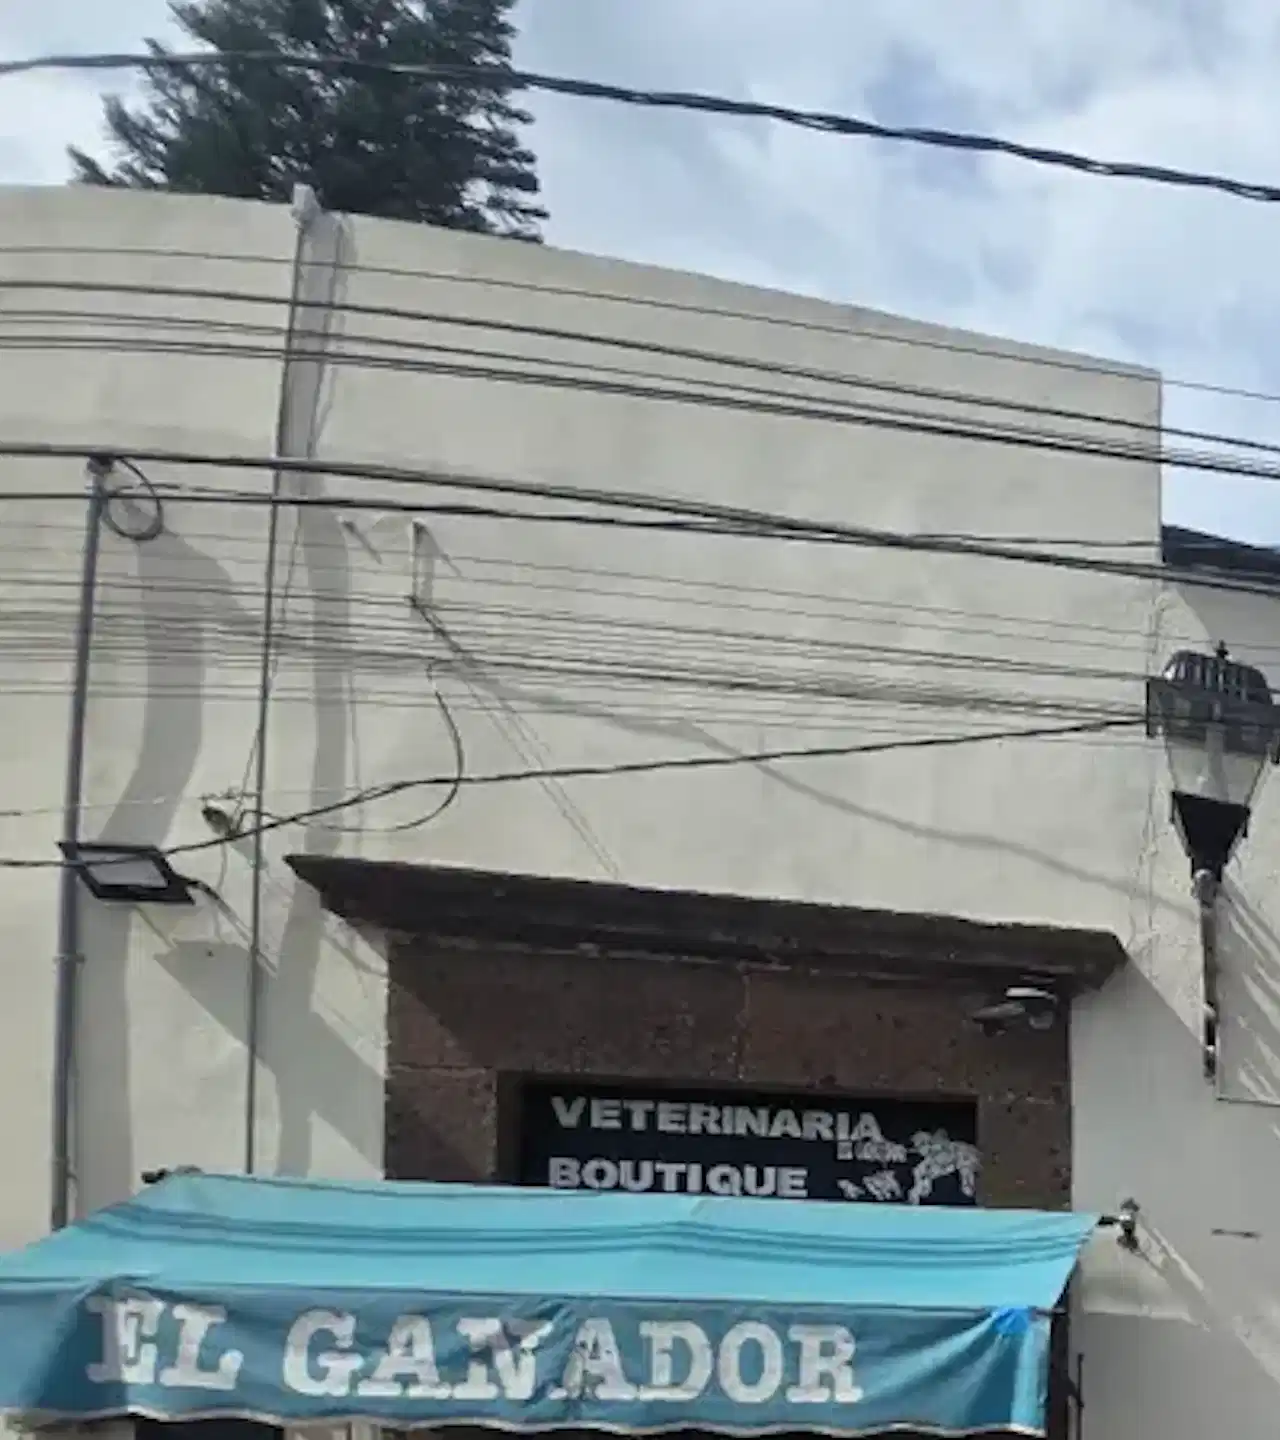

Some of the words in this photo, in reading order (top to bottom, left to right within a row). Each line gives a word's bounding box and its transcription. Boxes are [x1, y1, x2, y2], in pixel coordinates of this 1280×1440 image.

[550, 1096, 884, 1142] VETERINARIA
[549, 1156, 809, 1198] BOUTIQUE
[85, 1290, 244, 1391] EL
[283, 1305, 865, 1404] GANADOR
